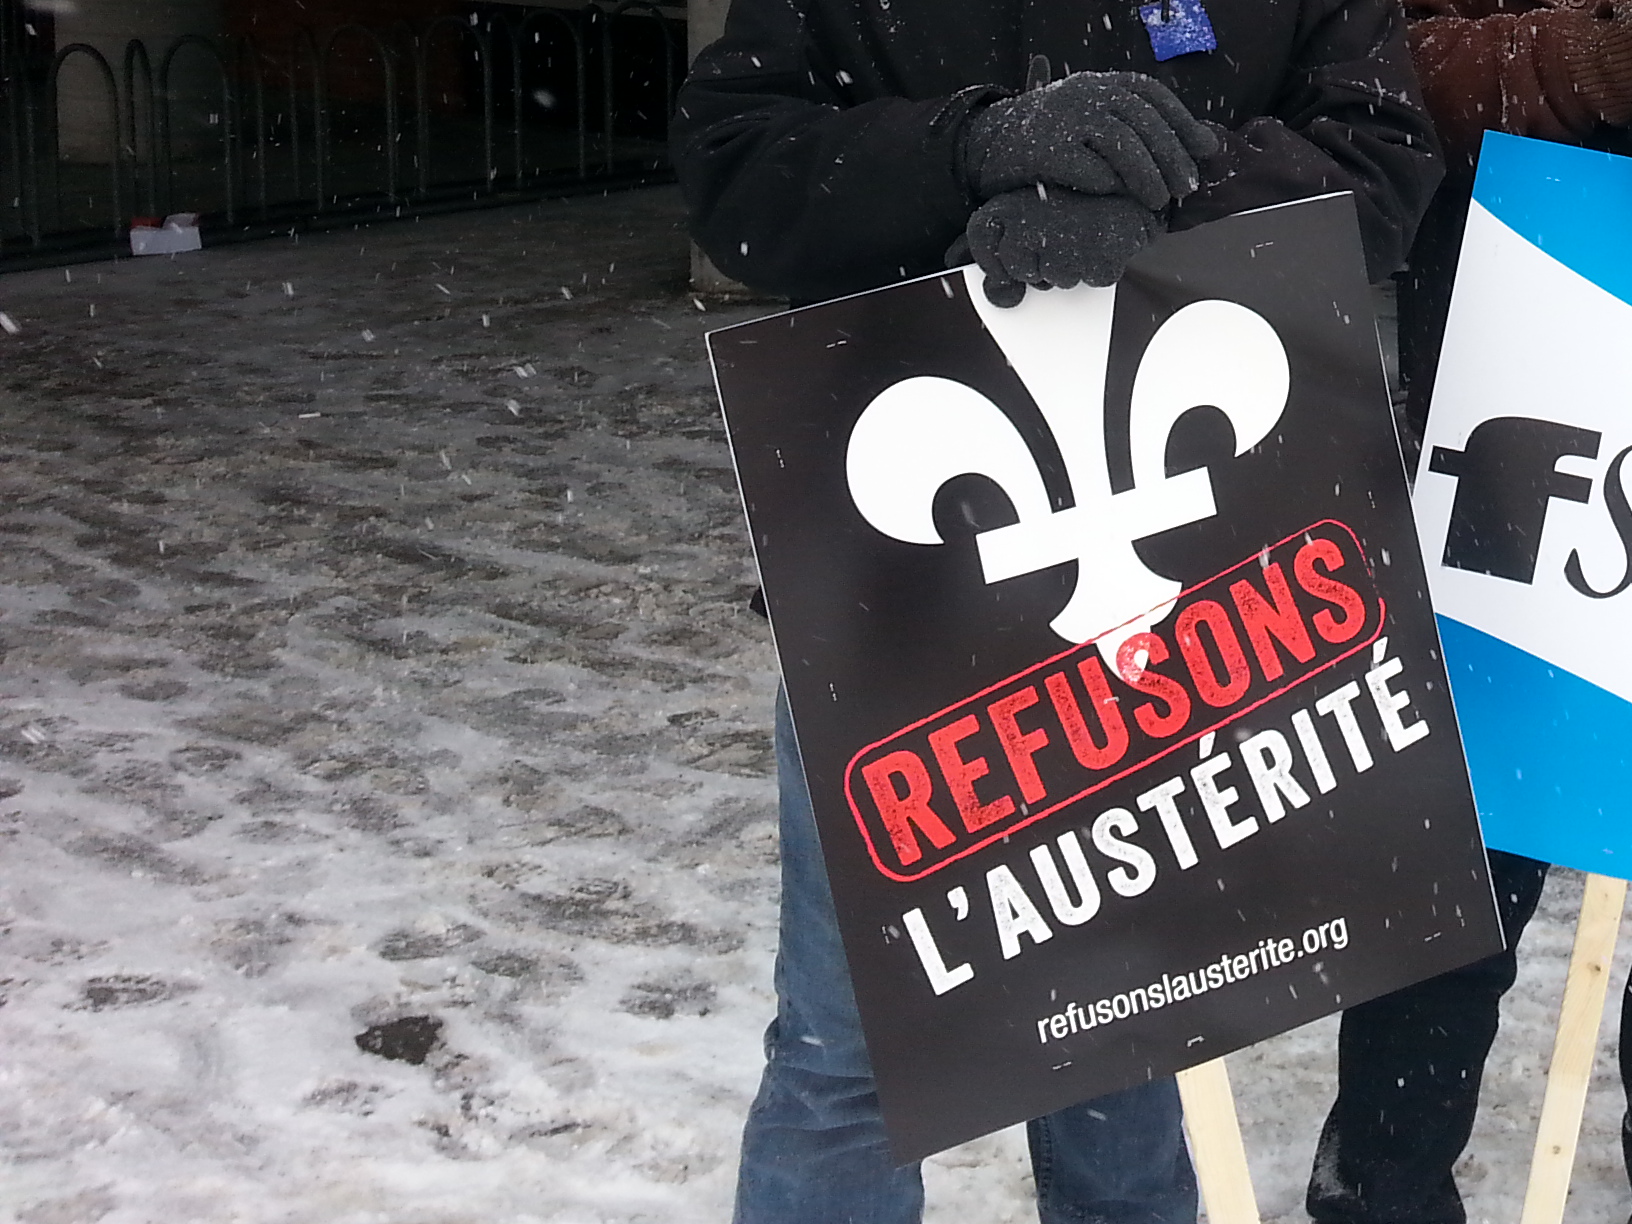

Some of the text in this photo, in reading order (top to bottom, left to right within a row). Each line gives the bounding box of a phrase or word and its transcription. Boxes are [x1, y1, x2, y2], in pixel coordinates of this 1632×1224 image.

[862, 538, 1367, 866] REFUSONS
[903, 637, 1431, 996] L'AUSTÉRITÉ
[1037, 916, 1349, 1044] refusonslausterite.org
